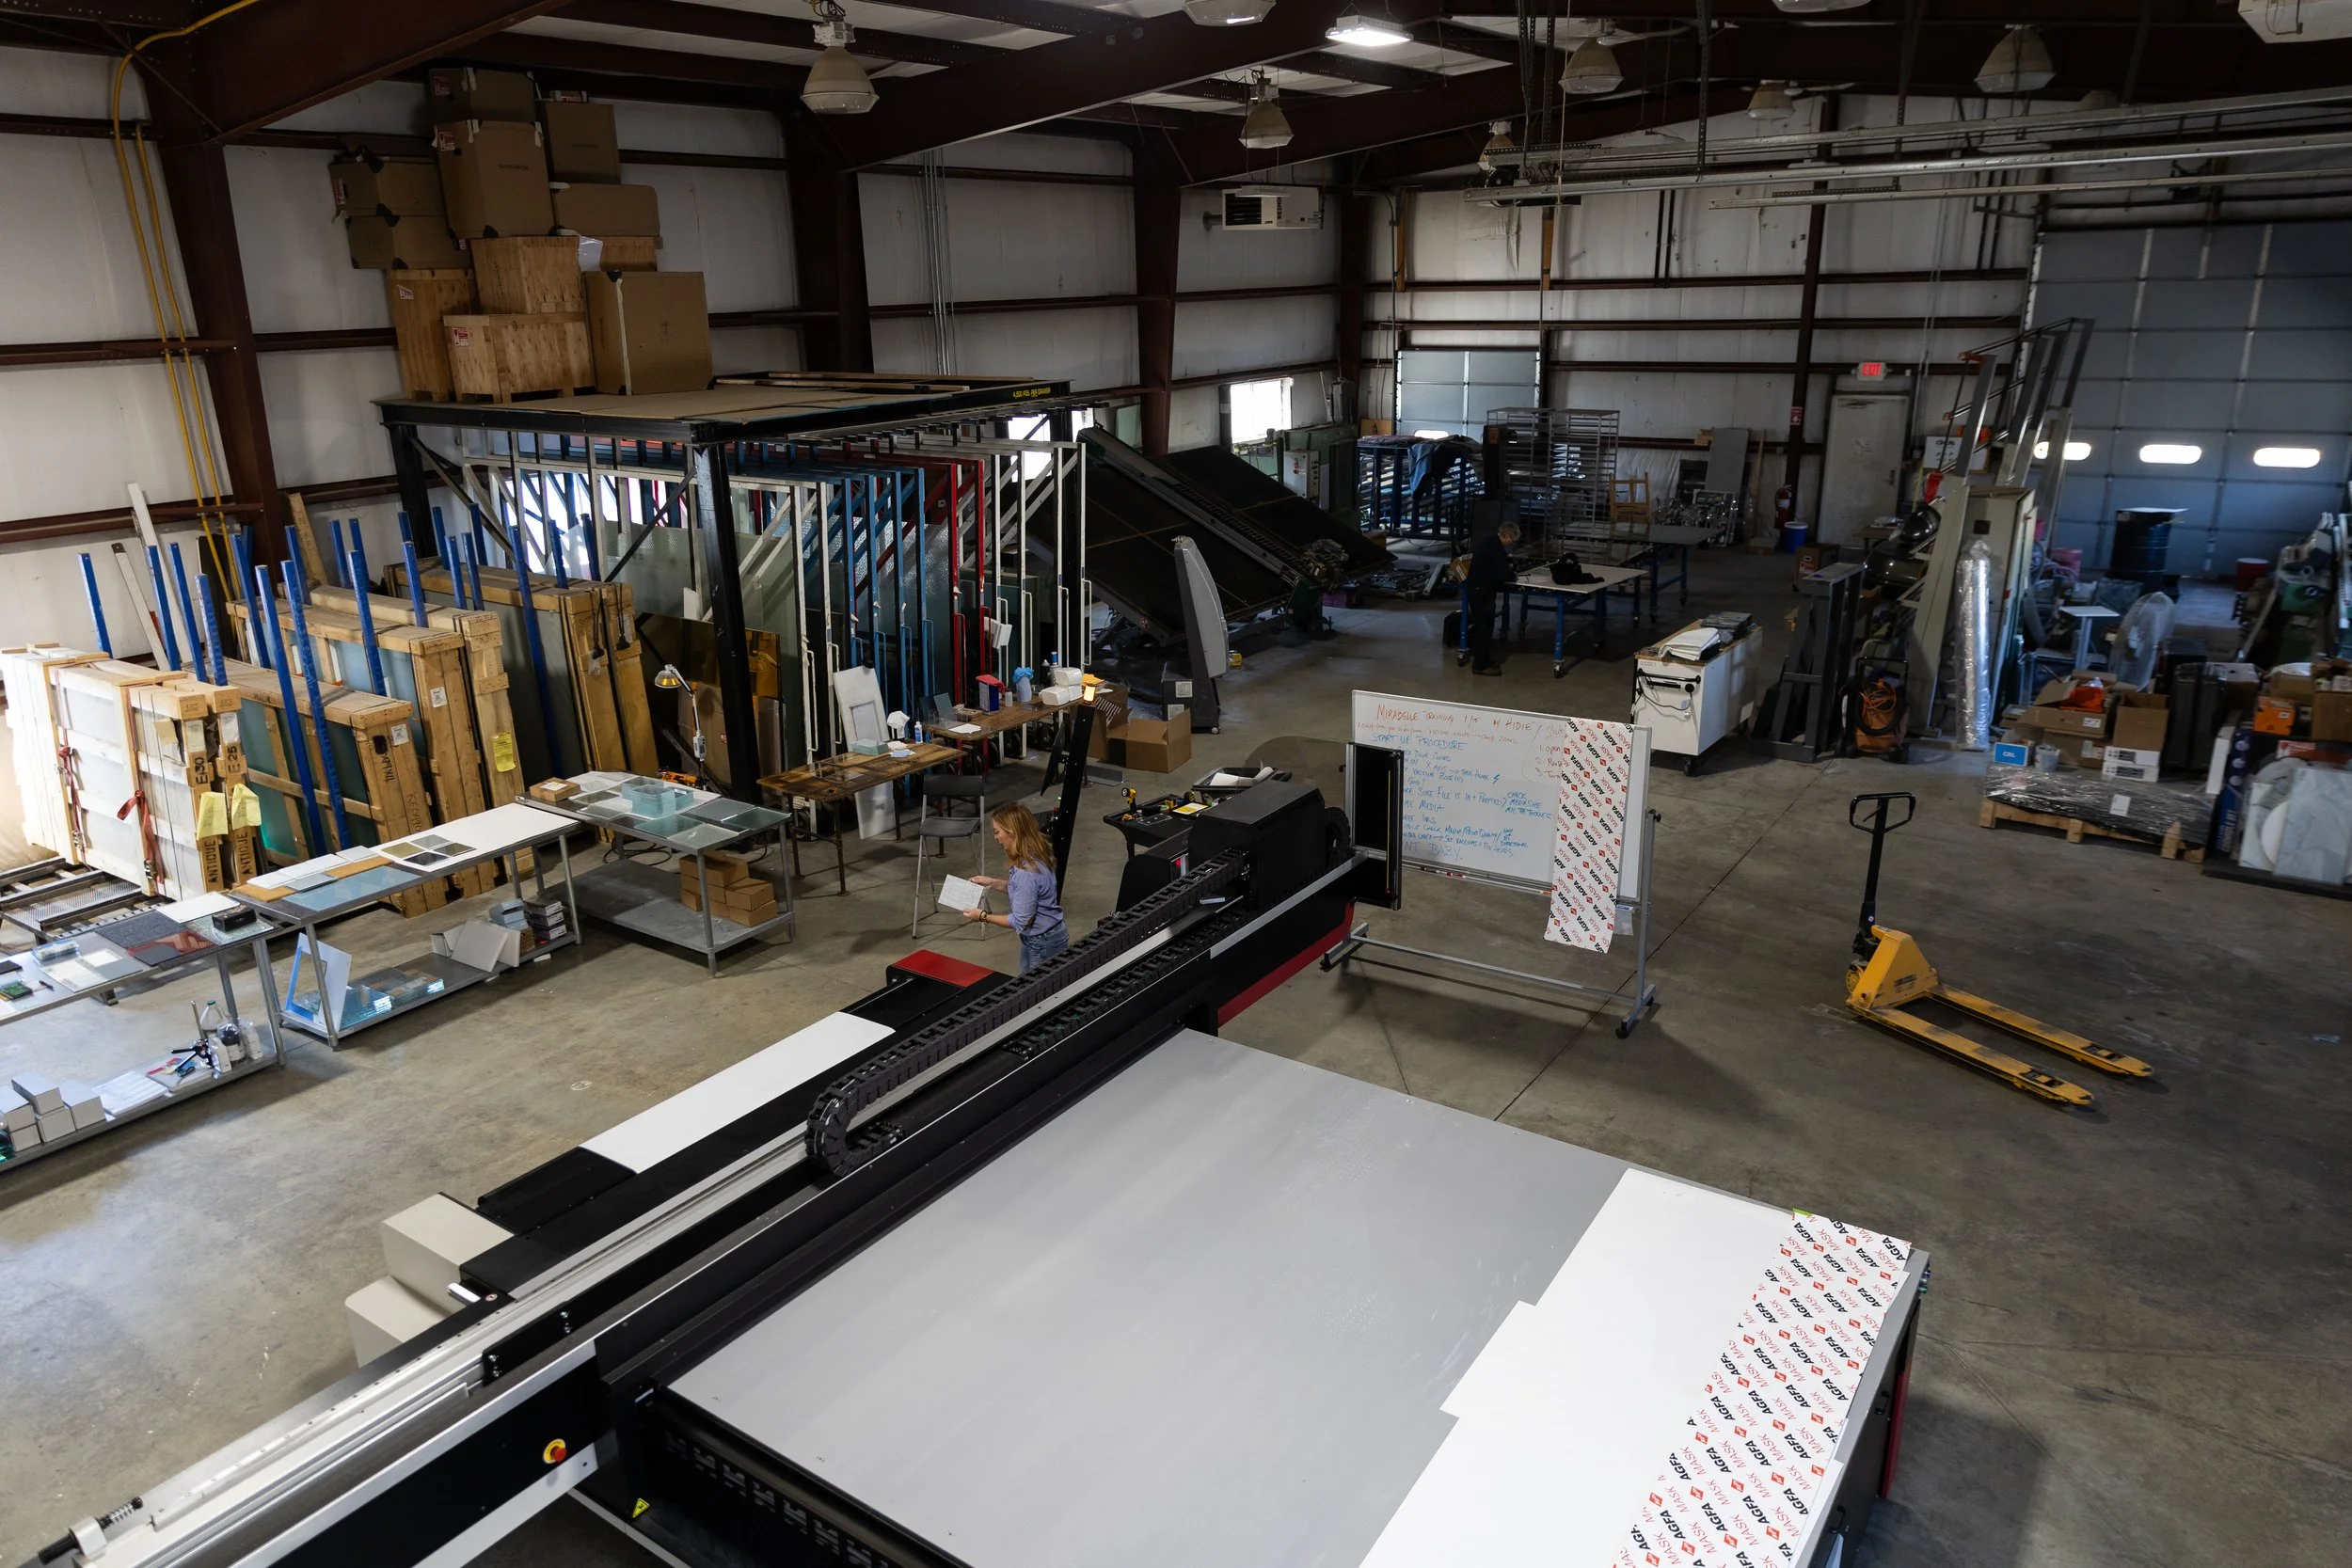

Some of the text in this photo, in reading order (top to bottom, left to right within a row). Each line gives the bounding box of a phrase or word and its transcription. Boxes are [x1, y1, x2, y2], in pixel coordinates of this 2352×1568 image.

[1862, 362, 1881, 375] EXIT
[1423, 710, 1454, 725] TRAINING
[1505, 715, 1536, 730] HIDIE
[1371, 734, 1398, 743] START
[1400, 736, 1413, 744] UP
[1417, 736, 1468, 751] PROCEDURE
[1585, 726, 1599, 742] MASK
[1603, 730, 1617, 746] AGFA
[1569, 739, 1583, 754] MASK
[1586, 742, 1601, 759] AGFA
[1600, 745, 1615, 762] MASK
[1570, 755, 1585, 771] AGFA
[1584, 757, 1599, 774] MASK
[1572, 770, 1587, 787] MASK
[1606, 766, 1621, 782] AGFA
[1437, 786, 1451, 799] FILE
[1465, 792, 1471, 801] IN
[1590, 779, 1605, 795] AGFA
[1601, 777, 1616, 795] MASK
[1418, 799, 1445, 812] MEDIA
[1578, 792, 1592, 807] AGFA
[1588, 790, 1603, 807] MASK
[1561, 804, 1576, 820] AGFA
[1573, 802, 1587, 819] MASK
[1605, 812, 1618, 827] MASK
[1599, 818, 1613, 834] AGFA
[1574, 836, 1587, 851] MASK
[1583, 830, 1597, 846] AGFA
[237, 831, 253, 879] ANTIQUE
[1558, 848, 1571, 862] MASK
[1567, 841, 1581, 857] AGFA
[1604, 843, 1618, 860] MASK
[203, 839, 219, 884] ANTIQUE
[1555, 856, 1566, 869] AGF
[1588, 854, 1603, 871] MASK
[1605, 858, 1618, 874] AGFA
[1572, 865, 1587, 883] MASK
[1589, 869, 1603, 885] AGFA
[1603, 873, 1616, 890] MASK
[1556, 877, 1571, 894] MASK
[1573, 880, 1587, 896] AGFA
[1587, 884, 1602, 901] MASK
[1558, 891, 1572, 907] AGFA
[1571, 895, 1586, 912] MASK
[1556, 906, 1569, 923] MASK
[1593, 904, 1607, 920] AGFA
[1576, 915, 1590, 932] AGFA
[1559, 927, 1572, 942] AGFA
[1794, 1222, 1815, 1242] AGFA
[1818, 1229, 1840, 1251] MASK
[1785, 1236, 1808, 1256] MASK
[1882, 1237, 1907, 1261] AGFA
[1823, 1254, 1846, 1272] AGFA
[1842, 1256, 1867, 1276] MASK
[1856, 1248, 1879, 1267] AGFA
[1876, 1249, 1900, 1271] MASK
[1777, 1266, 1801, 1286] MASK
[1790, 1259, 1813, 1277] AGFA
[1810, 1261, 1834, 1282] MASK
[1803, 1295, 1826, 1313] MASK
[1823, 1293, 1847, 1312] AGFA
[1837, 1289, 1860, 1308] MASK
[1858, 1288, 1882, 1307] AGFA
[1755, 1303, 1778, 1323] AGFA
[1770, 1299, 1792, 1319] MASK
[1790, 1298, 1813, 1317] AGFA
[1793, 1325, 1818, 1347] MASK
[1827, 1319, 1853, 1342] MASK
[1756, 1330, 1781, 1353] MASK
[1825, 1336, 1850, 1358] AGFA
[1753, 1348, 1777, 1369] AGFA
[1789, 1342, 1814, 1364] AGFA
[1780, 1357, 1806, 1382] MASK
[1815, 1351, 1843, 1376] MASK
[1746, 1364, 1771, 1387] MASK
[1785, 1384, 1811, 1407] AGFA
[1822, 1378, 1848, 1400] AGFA
[1711, 1396, 1735, 1420] AGFA
[1748, 1390, 1773, 1414] AGFA
[1772, 1397, 1797, 1420] MASK
[1810, 1391, 1835, 1413] MASK
[1696, 1409, 1720, 1432] MASK
[1735, 1404, 1758, 1426] MASK
[1758, 1434, 1786, 1460] MASK
[1784, 1434, 1811, 1458] AGFA
[1796, 1427, 1824, 1454] MASK
[1680, 1446, 1707, 1475] MASK
[1706, 1447, 1731, 1472] AGFA
[1720, 1440, 1746, 1468] MASK
[1745, 1440, 1771, 1465] AGFA
[1747, 1472, 1772, 1498] MASK
[1786, 1465, 1813, 1490] MASK
[1665, 1486, 1690, 1513] MASK
[1707, 1479, 1731, 1505] MASK
[1783, 1488, 1808, 1514] AGFA
[1701, 1503, 1727, 1531] AGFA
[1742, 1495, 1769, 1523] AGFA
[1660, 1510, 1685, 1538] AGFA
[1732, 1514, 1759, 1546] MASK
[1775, 1506, 1802, 1537] MASK
[1688, 1521, 1718, 1554] MASK
[1654, 1532, 1681, 1565] MASK
